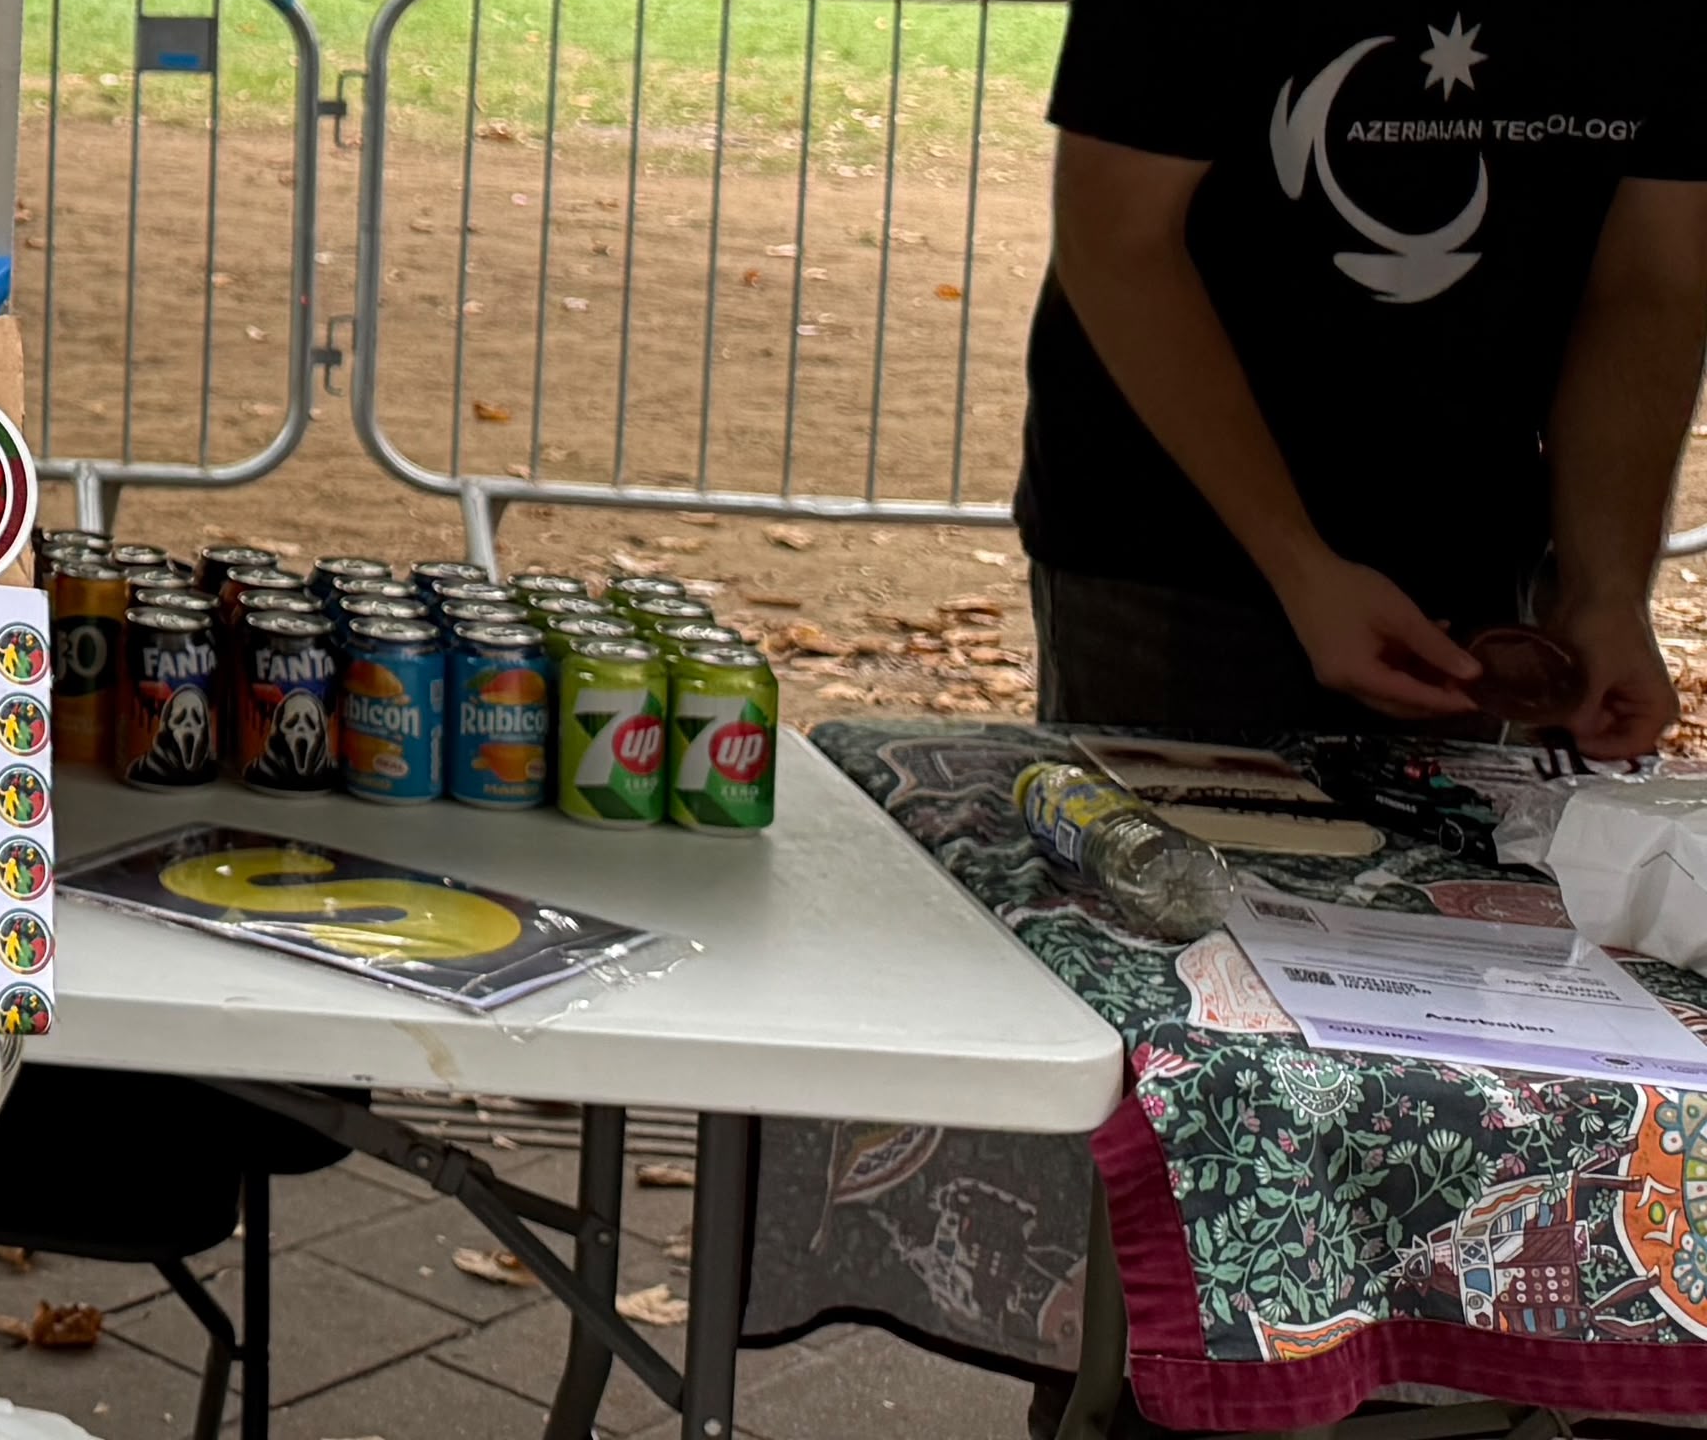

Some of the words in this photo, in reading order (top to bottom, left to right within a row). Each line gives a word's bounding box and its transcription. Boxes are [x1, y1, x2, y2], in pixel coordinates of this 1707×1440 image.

[1347, 119, 1483, 142] AZERBAIJAN
[143, 643, 217, 681] FANTA
[255, 647, 336, 682] FANTA
